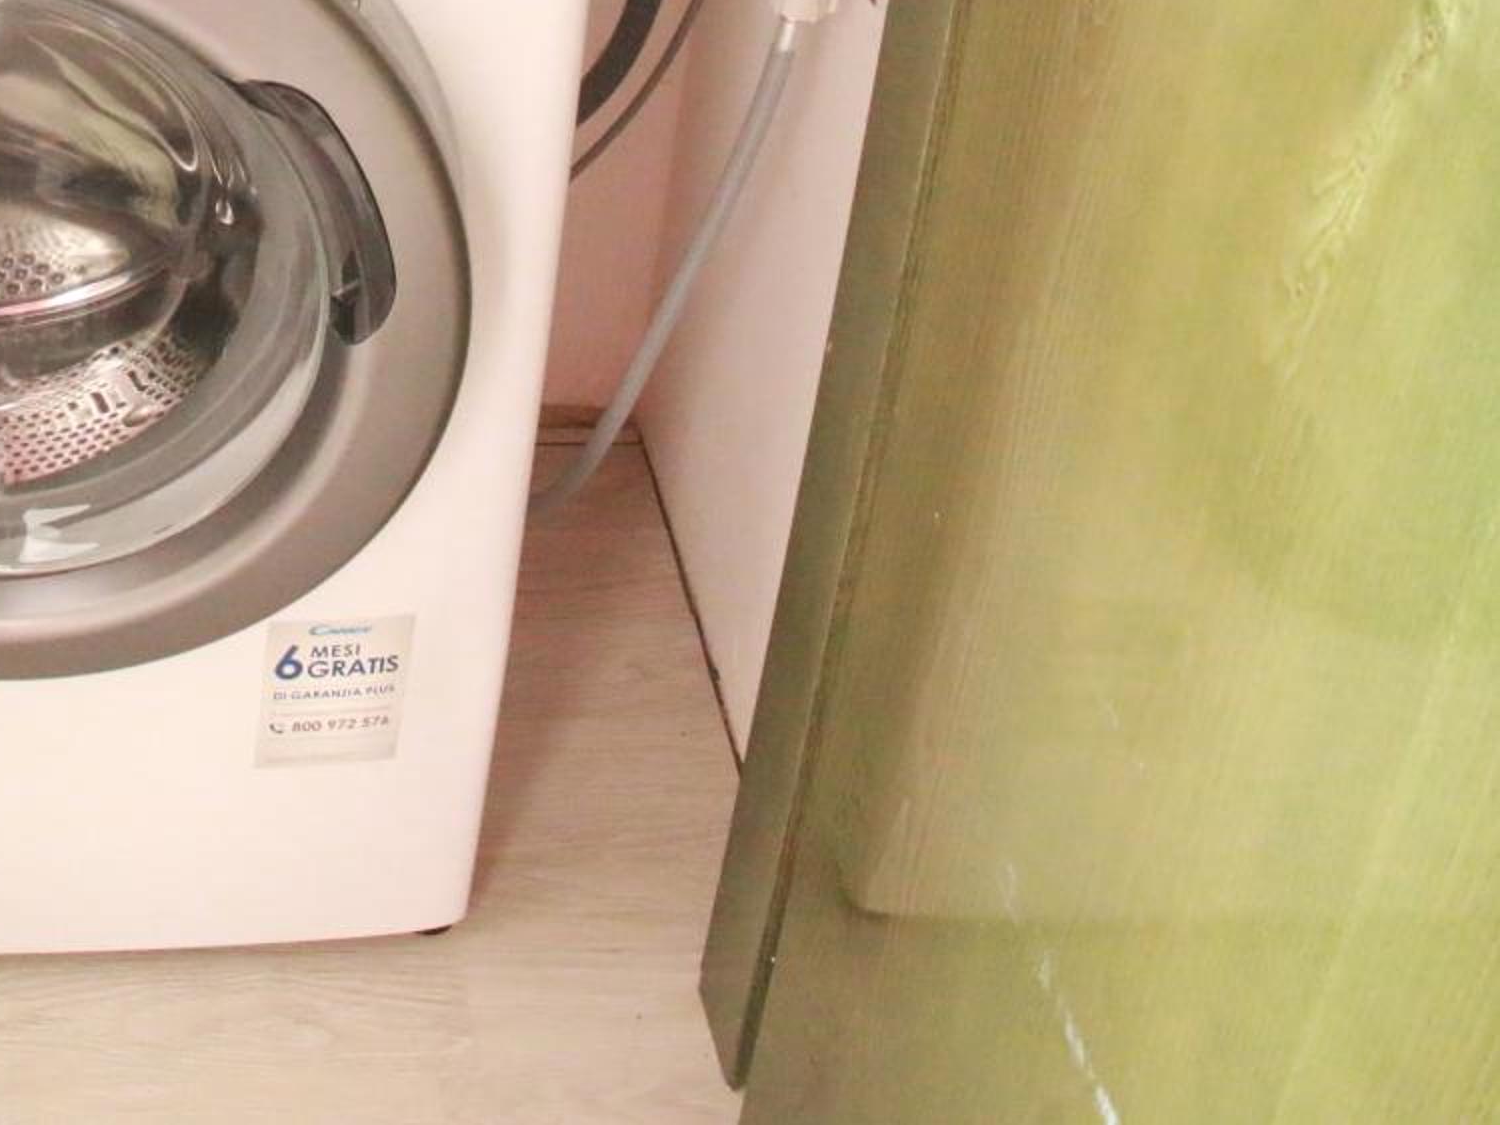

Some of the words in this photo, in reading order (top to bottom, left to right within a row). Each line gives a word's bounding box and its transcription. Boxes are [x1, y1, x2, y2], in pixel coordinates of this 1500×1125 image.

[274, 644, 303, 680] 6
[310, 644, 361, 658] MESI
[307, 655, 399, 678] GRATIS
